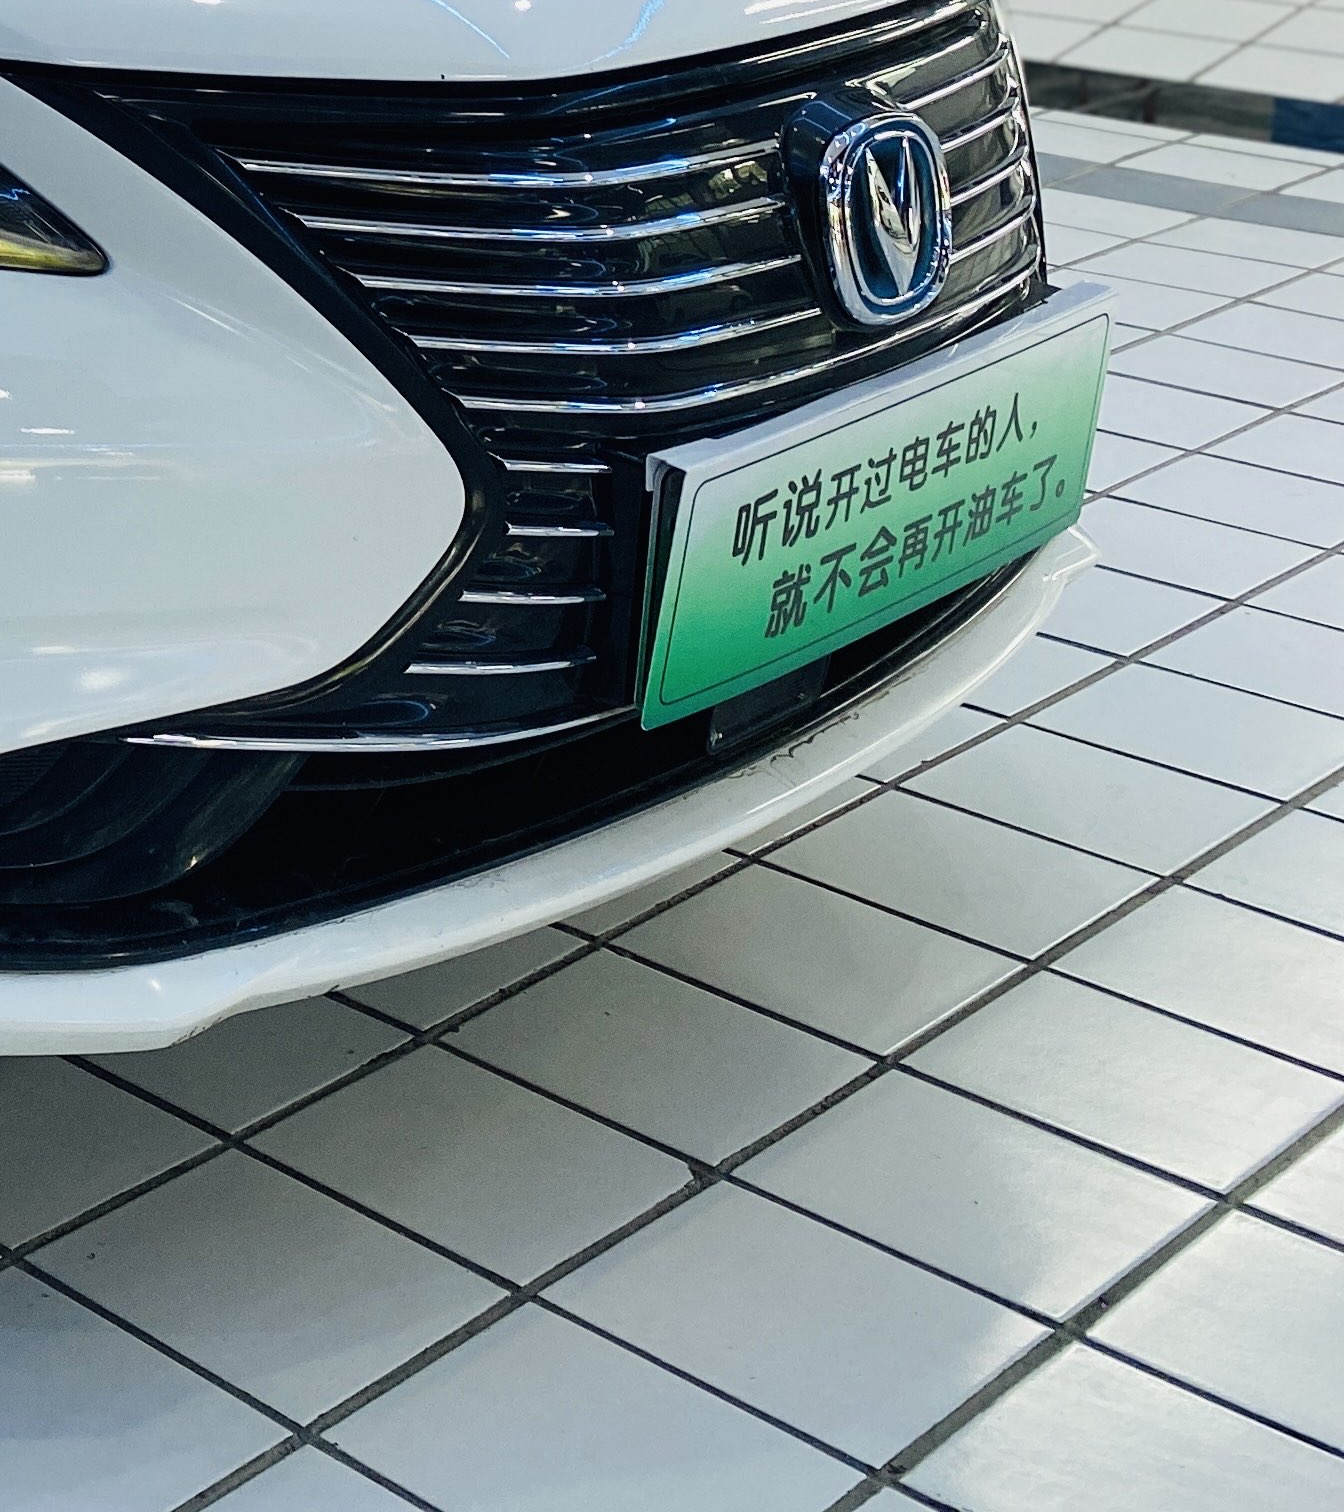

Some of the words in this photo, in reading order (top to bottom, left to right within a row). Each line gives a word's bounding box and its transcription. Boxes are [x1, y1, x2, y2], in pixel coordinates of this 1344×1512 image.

[730, 391, 1040, 567] 听说开过电车的人，
[764, 454, 1067, 640] 就不会再开油车了。
